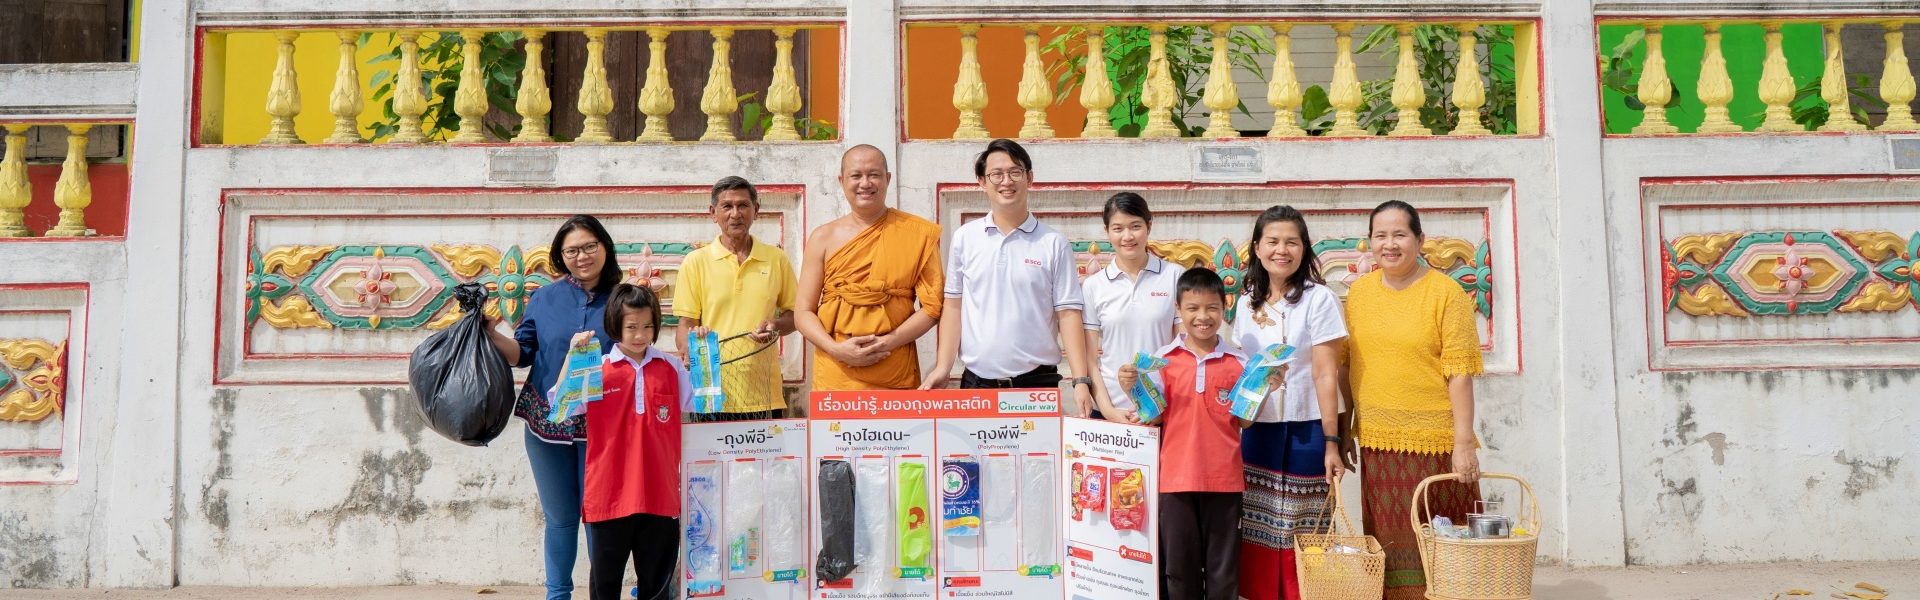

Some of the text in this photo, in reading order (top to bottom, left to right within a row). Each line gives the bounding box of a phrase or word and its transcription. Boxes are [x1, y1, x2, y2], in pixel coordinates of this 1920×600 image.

[1029, 392, 1057, 402] SCG
[818, 393, 991, 414] เรื่องน่ารู้..ของถุงพลาสติก
[998, 401, 1037, 411] Circular
